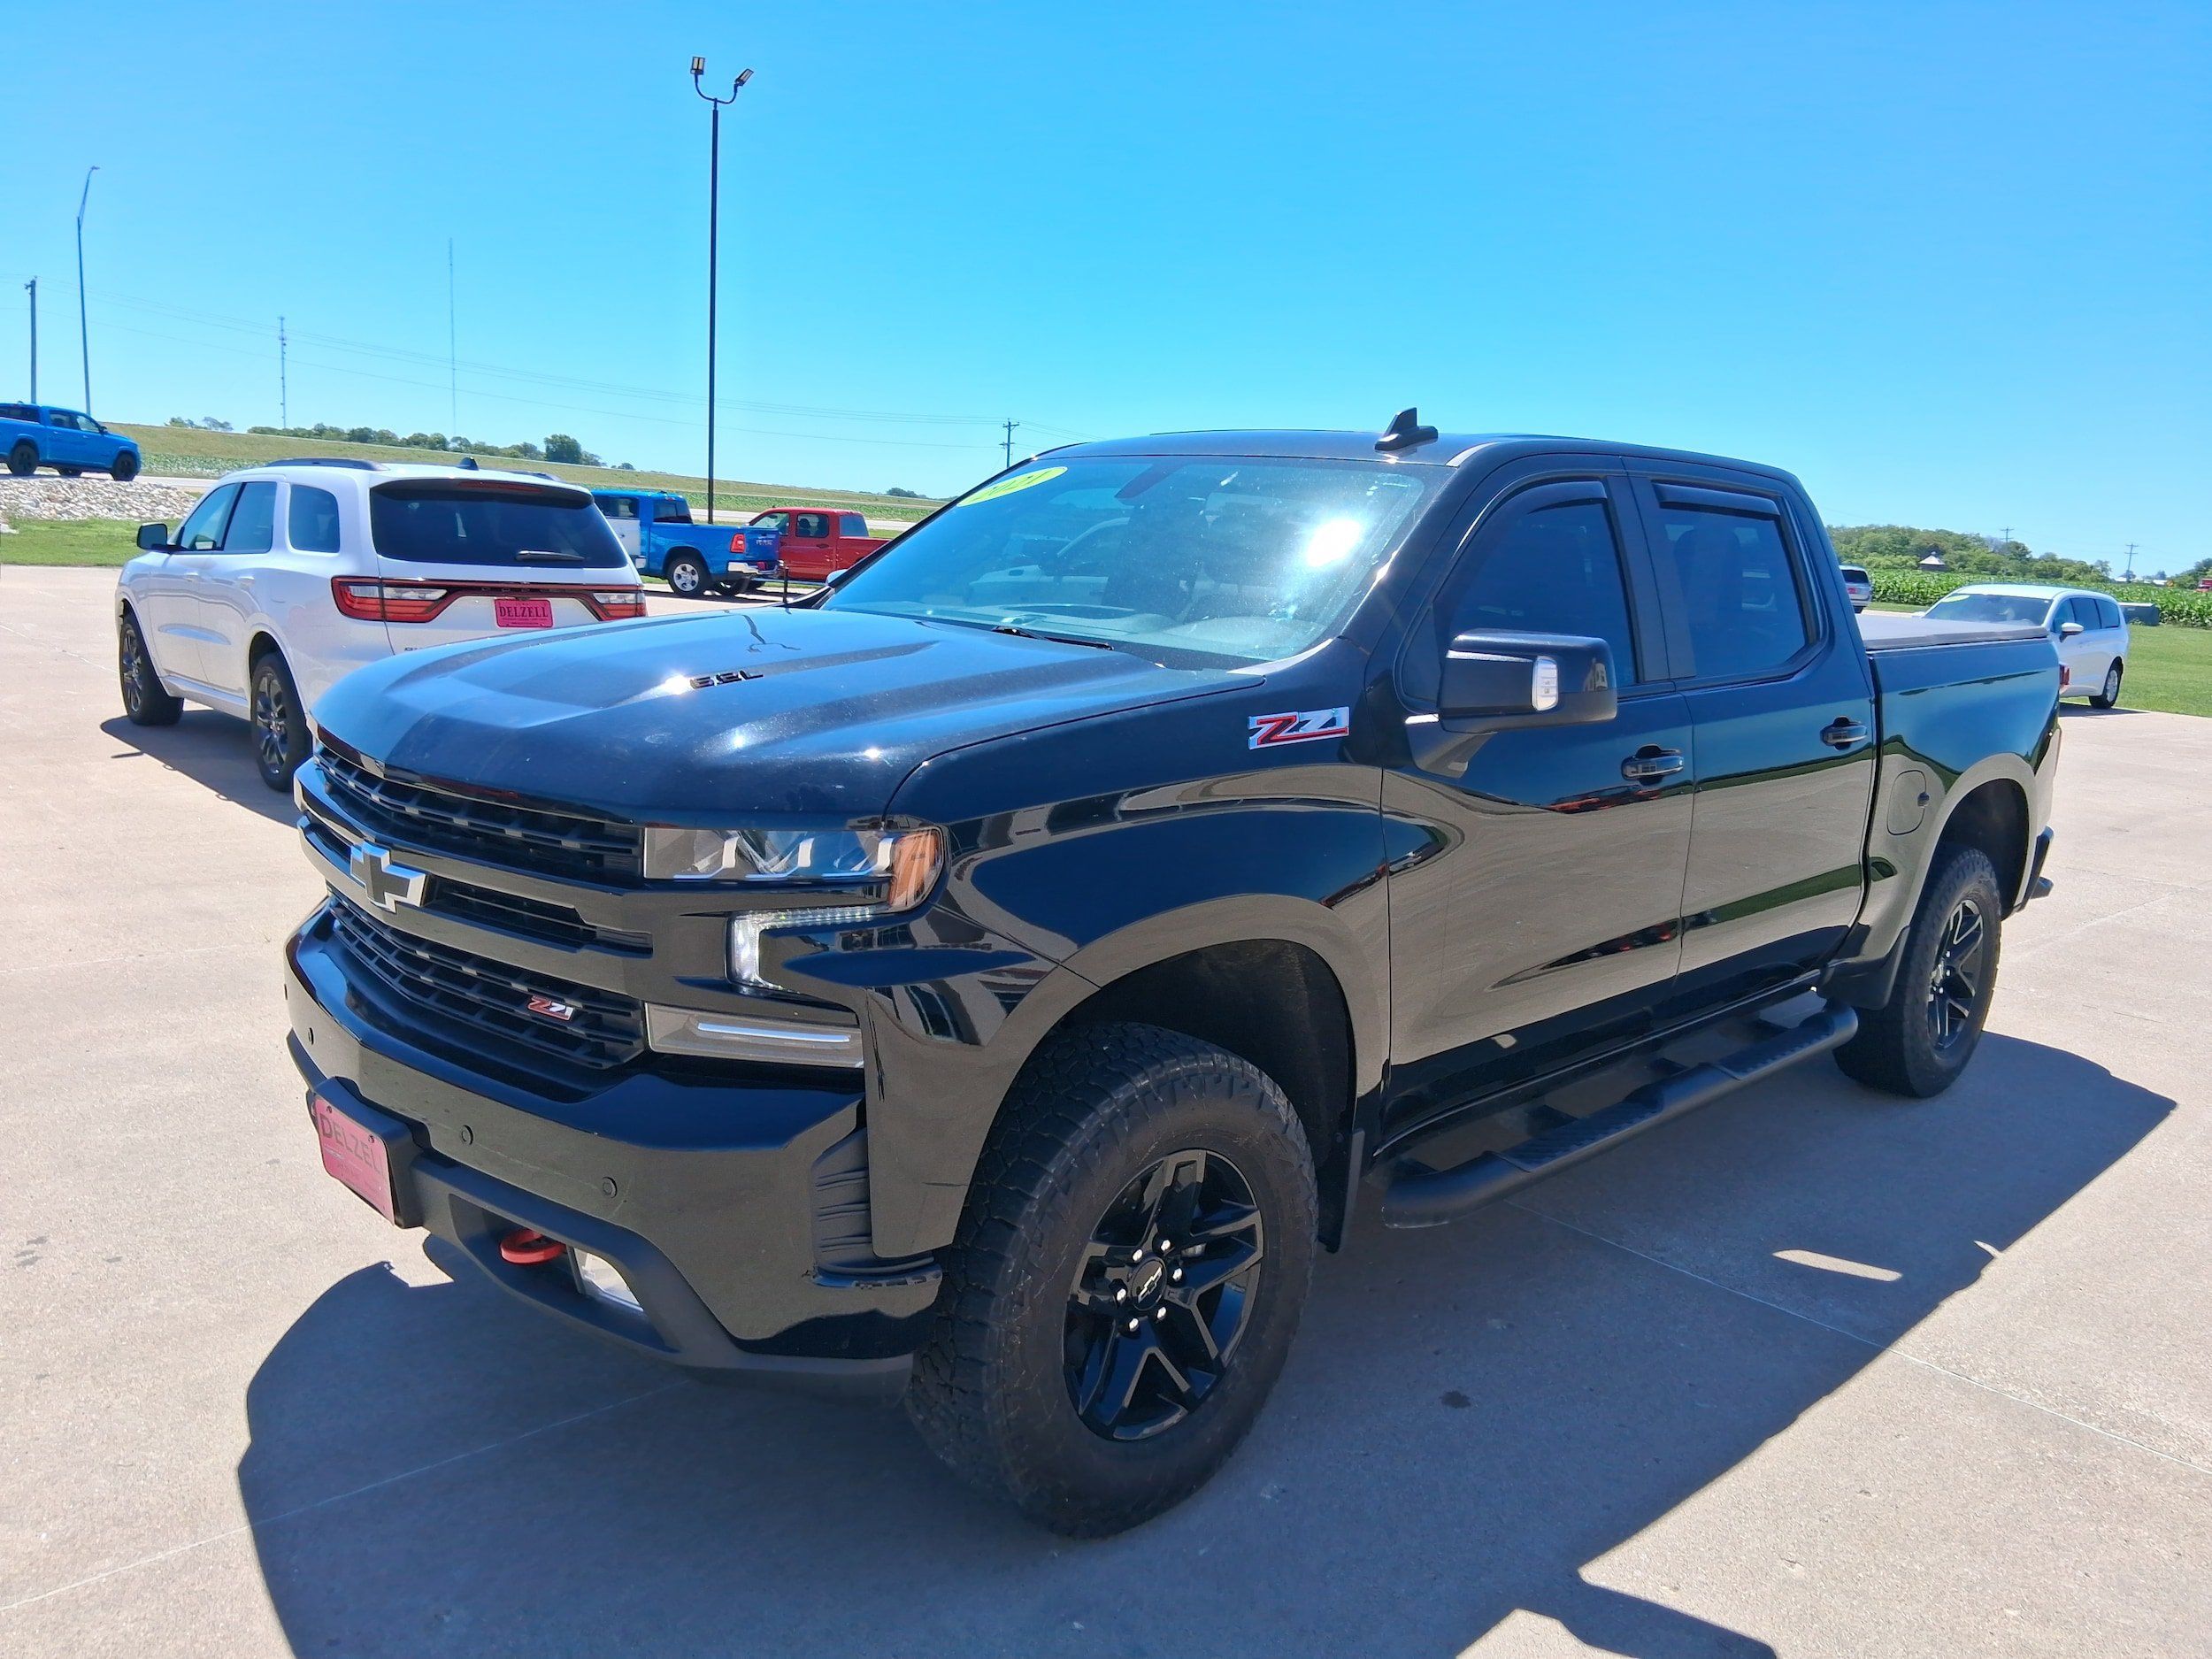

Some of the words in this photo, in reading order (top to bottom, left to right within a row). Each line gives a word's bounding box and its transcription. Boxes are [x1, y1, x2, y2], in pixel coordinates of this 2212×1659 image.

[499, 606, 549, 618] DELZELL
[1248, 706, 1350, 750] Z71
[527, 995, 575, 1021] Z71
